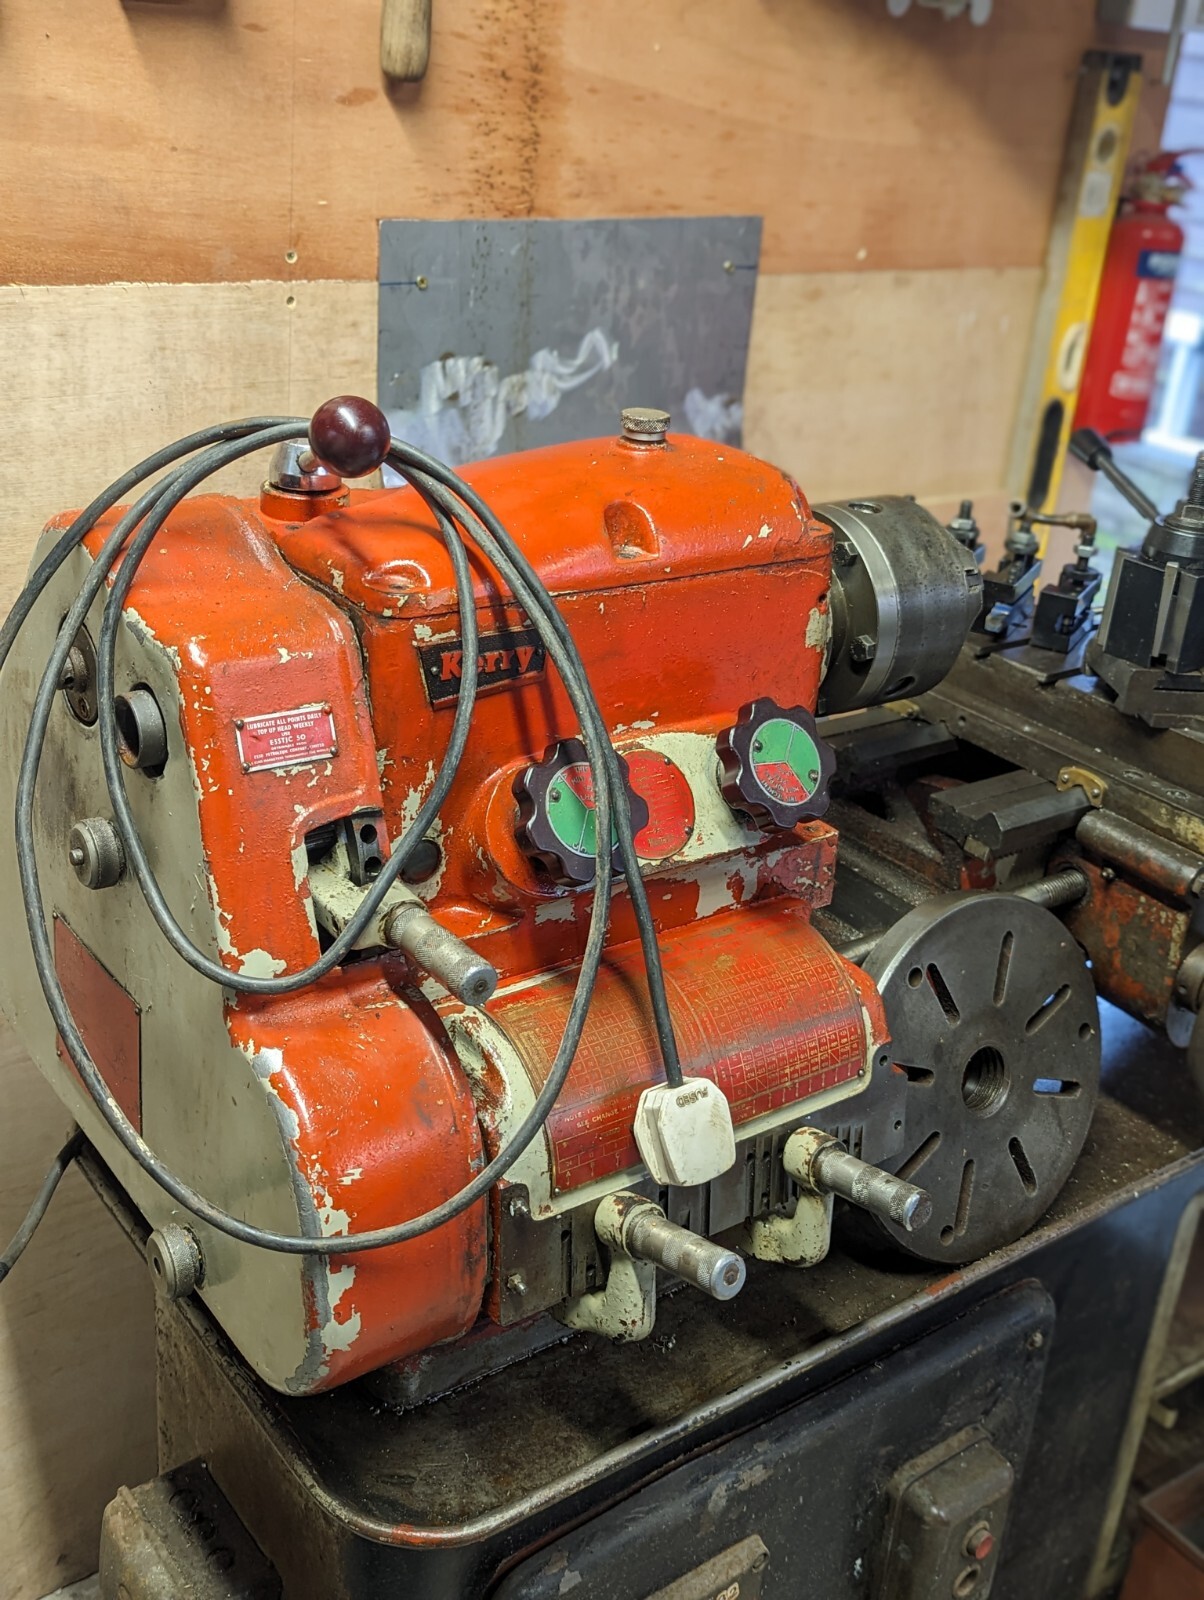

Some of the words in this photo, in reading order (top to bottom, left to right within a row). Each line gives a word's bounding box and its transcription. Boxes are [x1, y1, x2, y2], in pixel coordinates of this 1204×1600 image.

[247, 721, 275, 730] LUBRICATE
[293, 721, 314, 729] WEEKLY
[269, 736, 293, 745] ESSTIC
